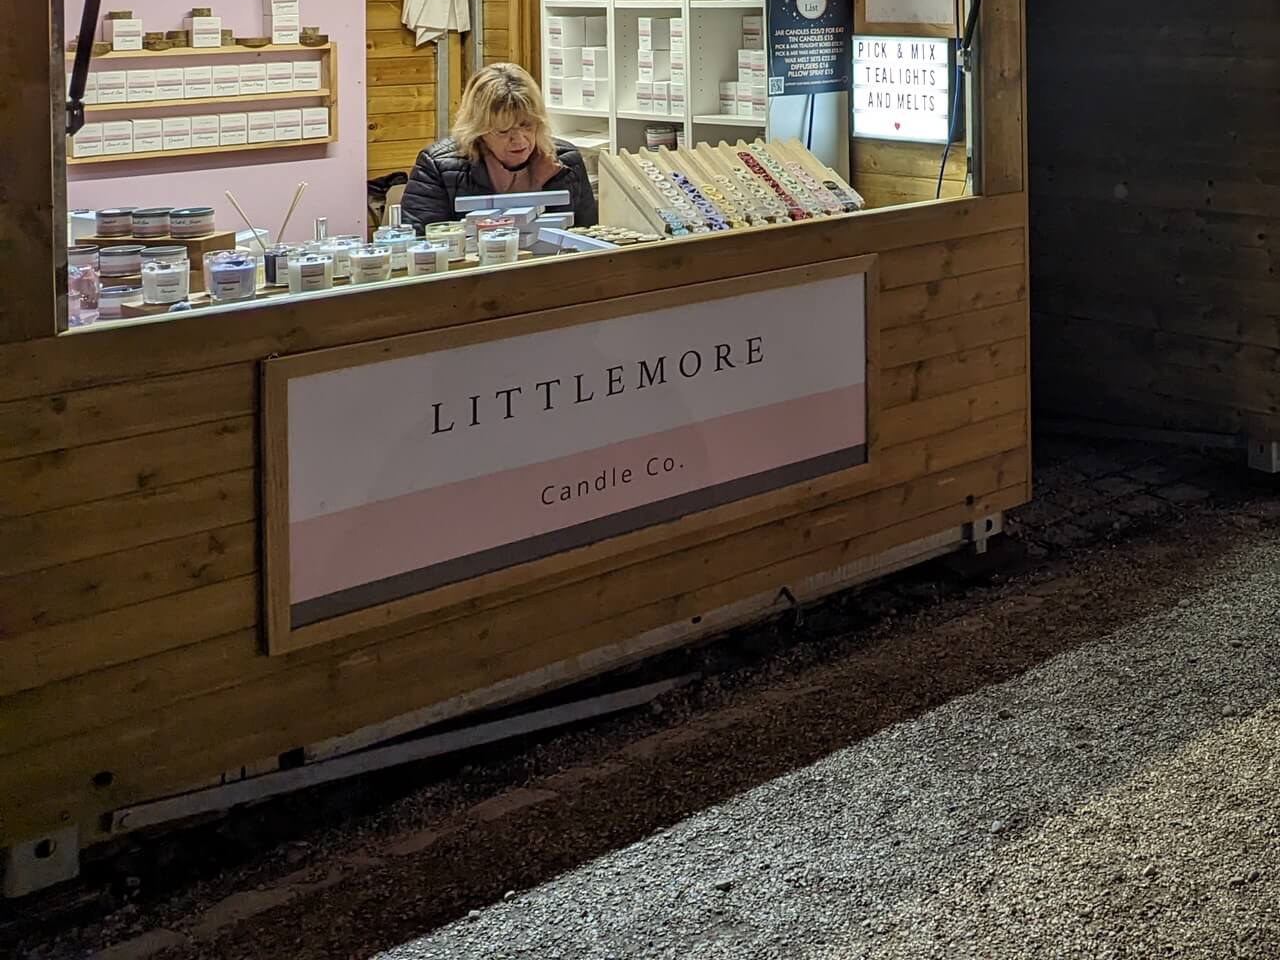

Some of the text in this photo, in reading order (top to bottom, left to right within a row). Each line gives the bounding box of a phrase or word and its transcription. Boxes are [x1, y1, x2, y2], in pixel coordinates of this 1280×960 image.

[804, 3, 818, 12] List
[785, 28, 809, 36] CANDLES
[858, 42, 936, 60] PICK & MIX
[790, 63, 819, 71] DIFFUSERS
[865, 67, 936, 86] TEALIGHTS
[867, 91, 935, 112] AND MELTS
[430, 336, 765, 435] LITTLEMORE
[541, 457, 684, 505] Candle Co.
